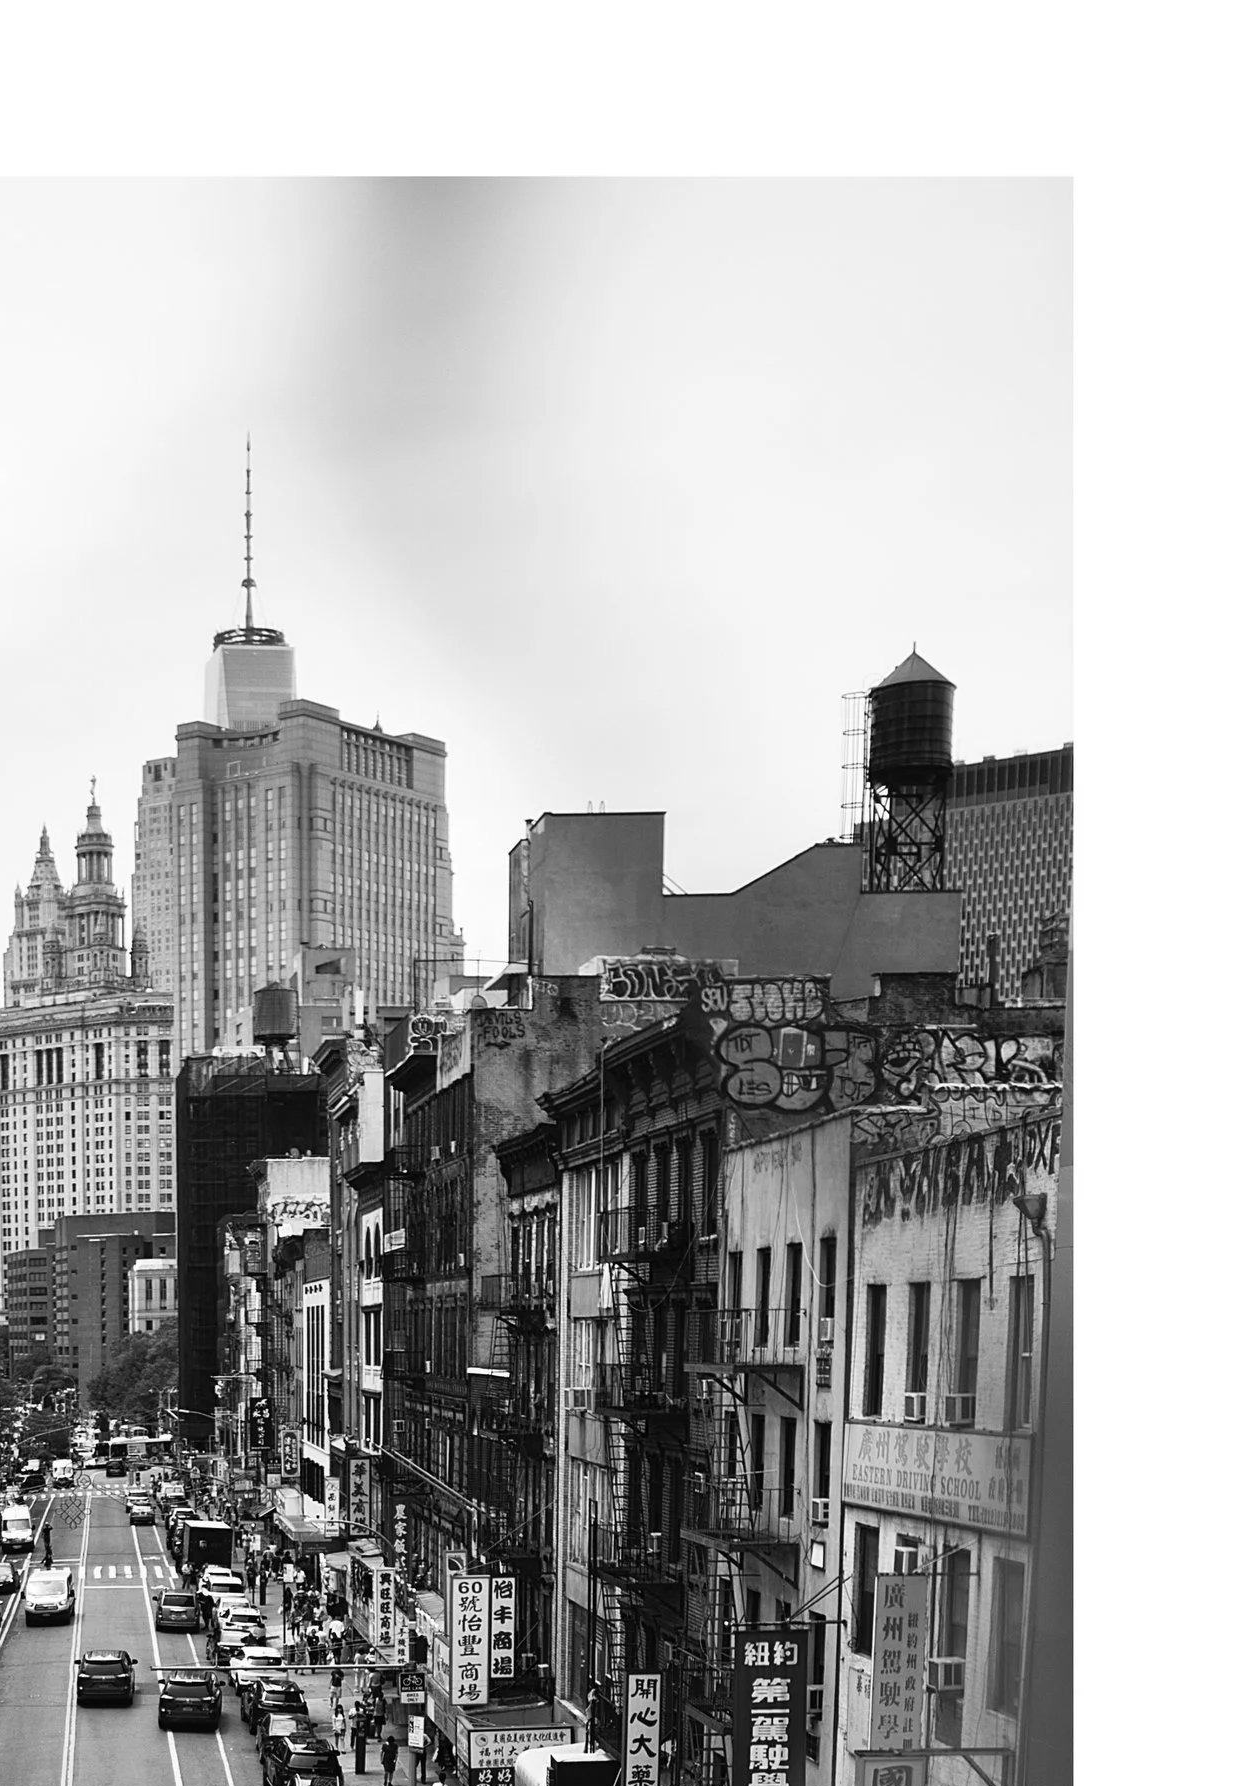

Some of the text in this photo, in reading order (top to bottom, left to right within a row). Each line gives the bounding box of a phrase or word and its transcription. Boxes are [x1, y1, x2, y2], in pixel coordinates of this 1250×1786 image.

[852, 1463, 893, 1487] EASTERN
[896, 1470, 936, 1494] DRIVING
[940, 1475, 981, 1500] SCHOOL
[743, 1640, 799, 1667] 紐約
[877, 1582, 907, 1750] 廣州駕駛學
